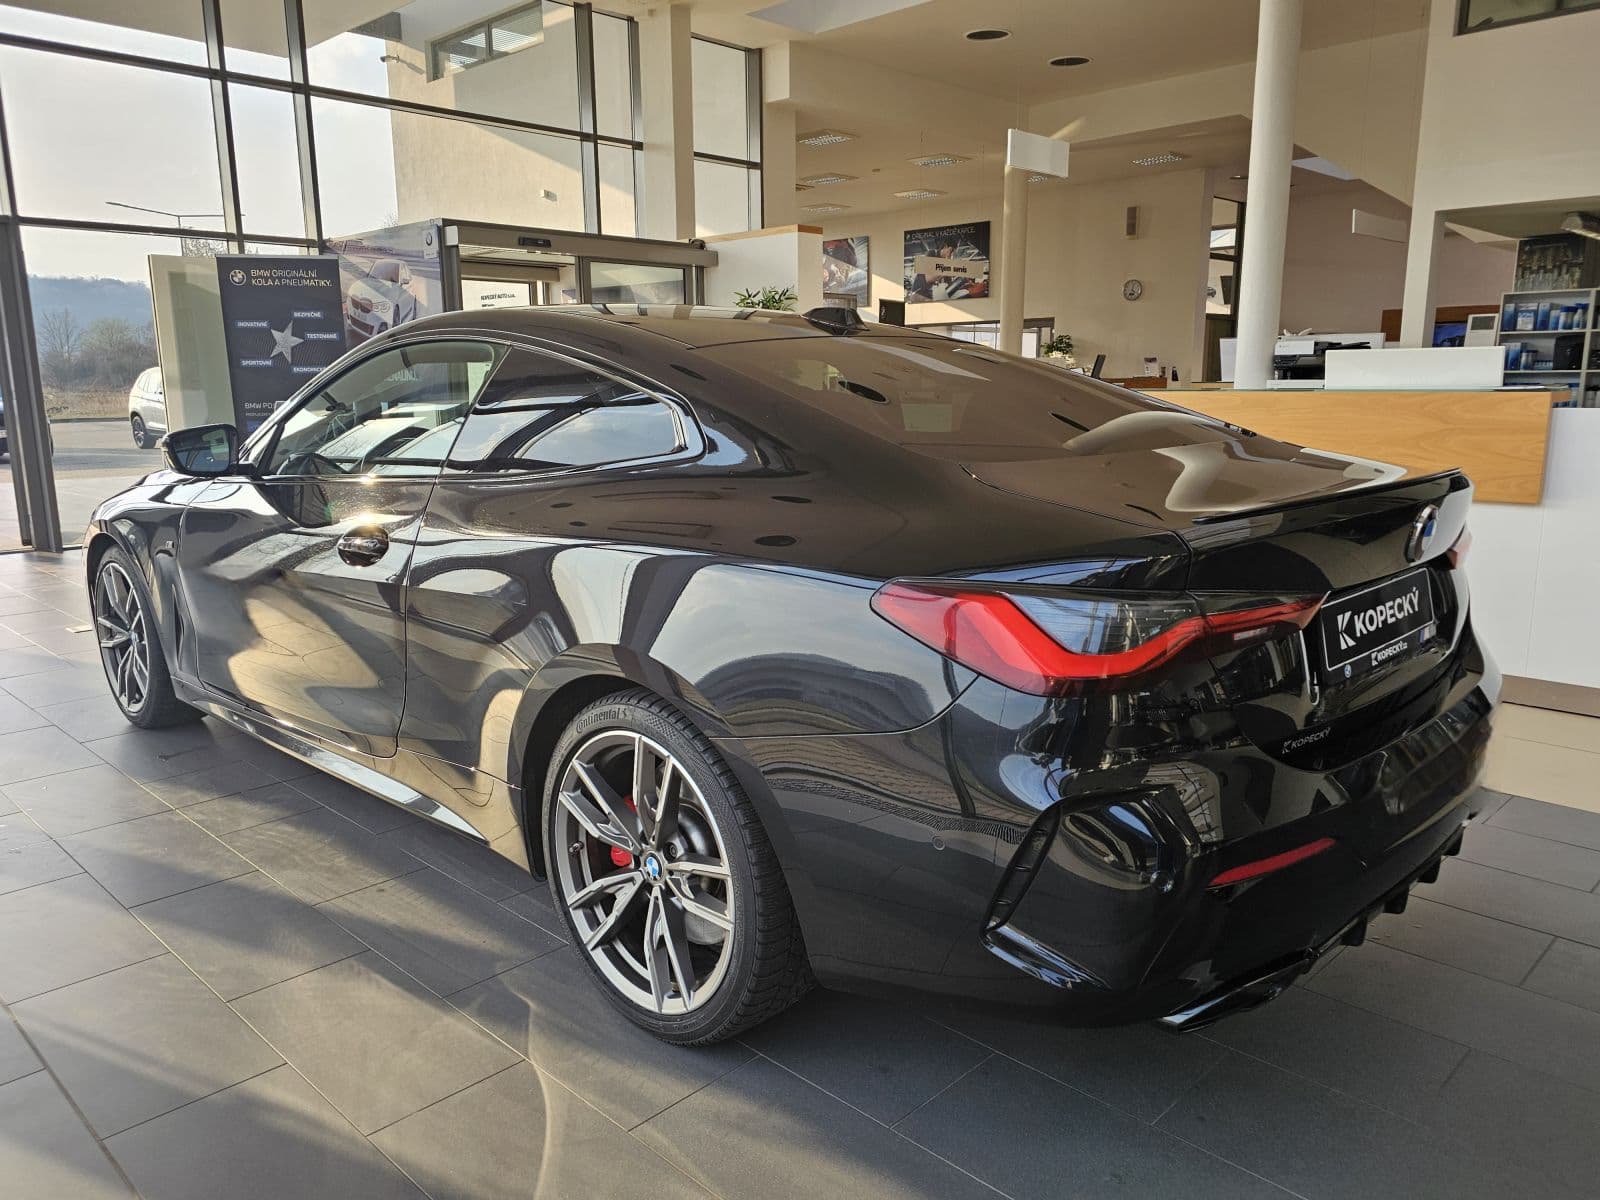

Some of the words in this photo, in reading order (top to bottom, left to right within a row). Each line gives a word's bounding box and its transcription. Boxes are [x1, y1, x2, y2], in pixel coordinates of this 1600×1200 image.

[251, 269, 271, 277] BMW
[271, 269, 317, 278] ORIGINÁLNÍ
[1353, 587, 1419, 638] KOPECKÝ
[576, 707, 621, 733] Continental
